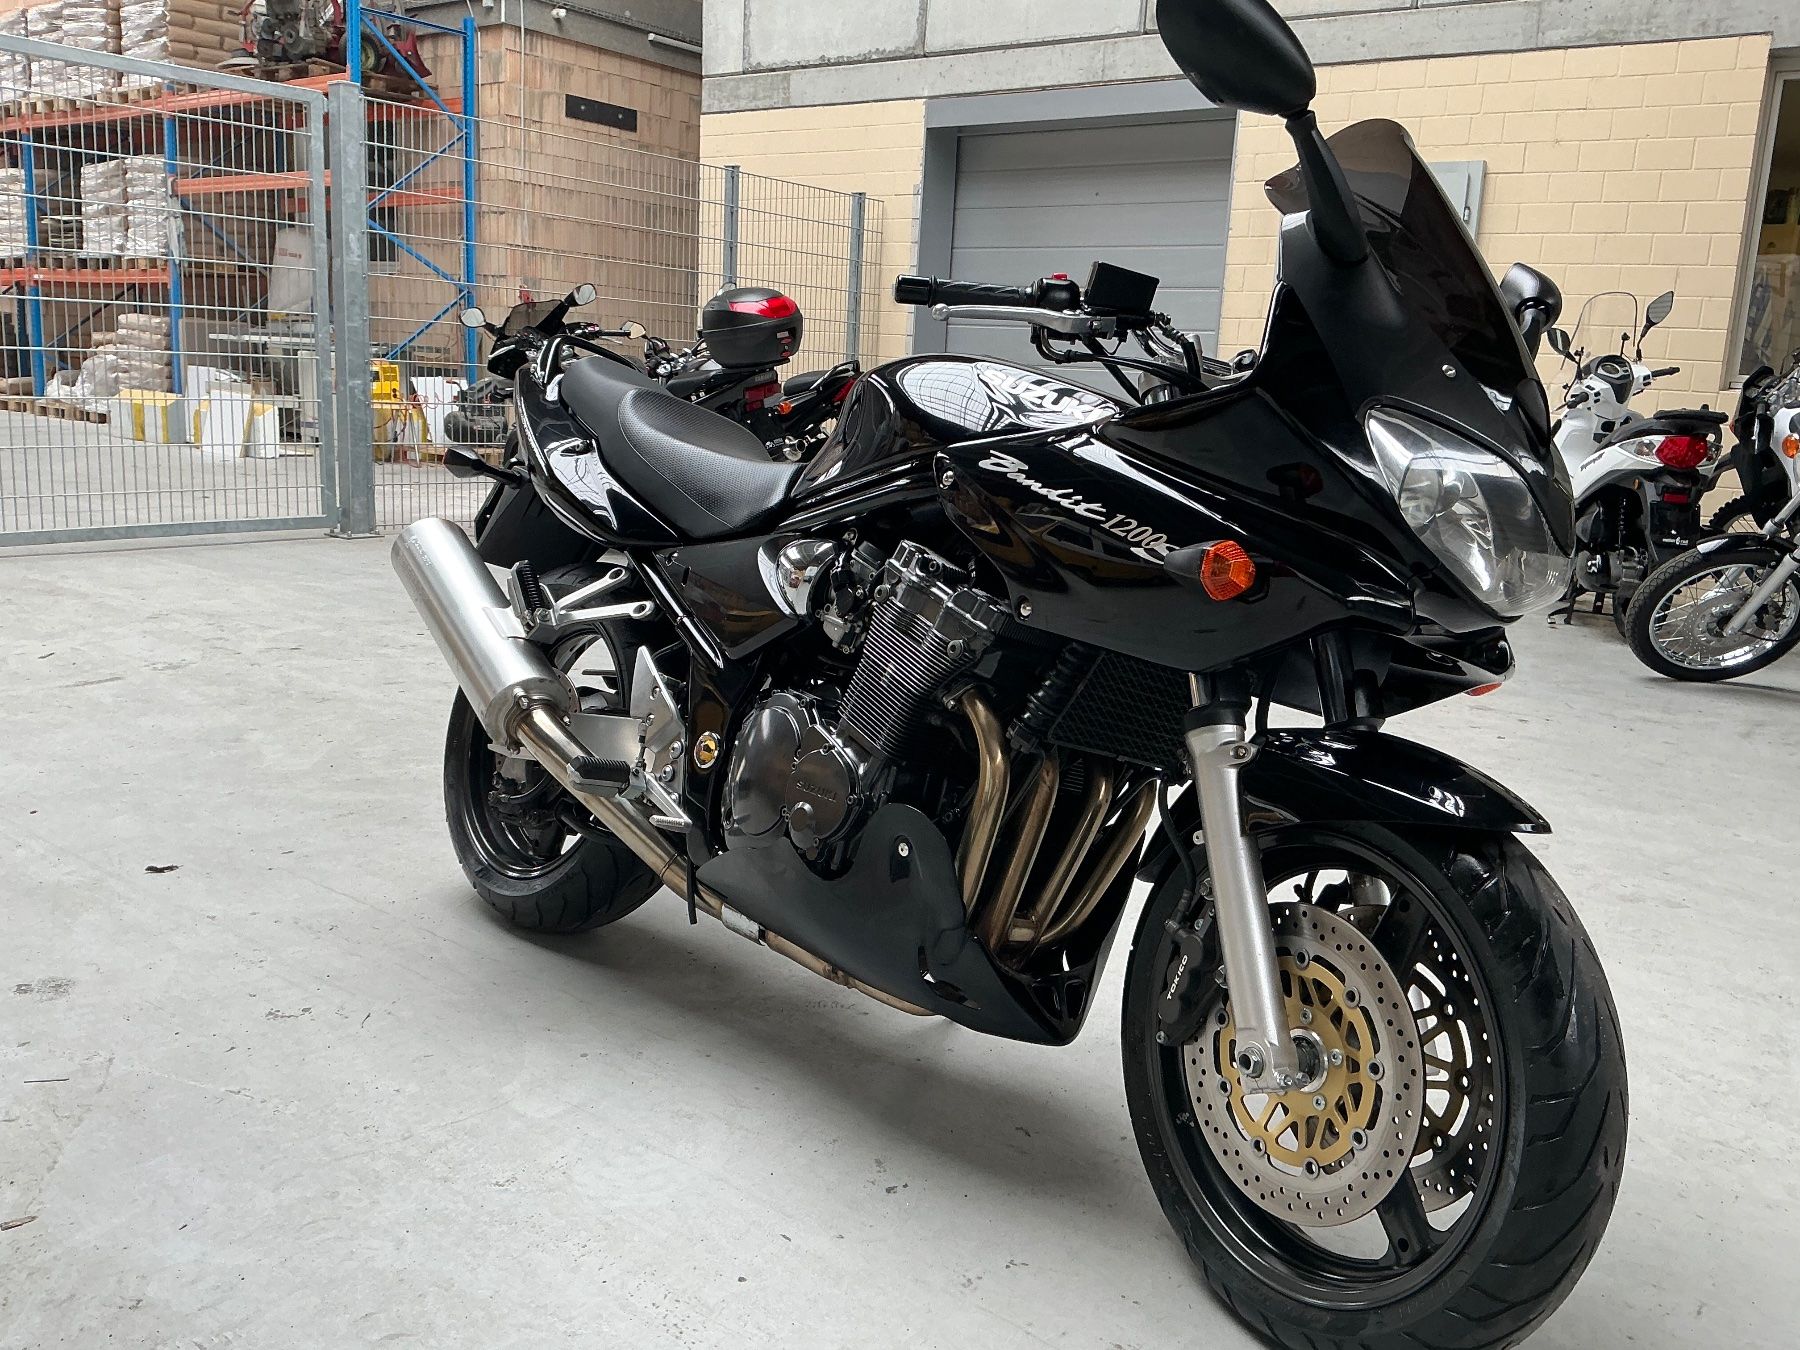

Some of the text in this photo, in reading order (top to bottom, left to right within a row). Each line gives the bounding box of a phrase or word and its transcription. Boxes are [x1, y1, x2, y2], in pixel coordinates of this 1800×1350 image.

[984, 368, 1105, 423] SUZUKI
[978, 450, 1106, 521] Bandit
[1166, 954, 1188, 1000] TOKICO
